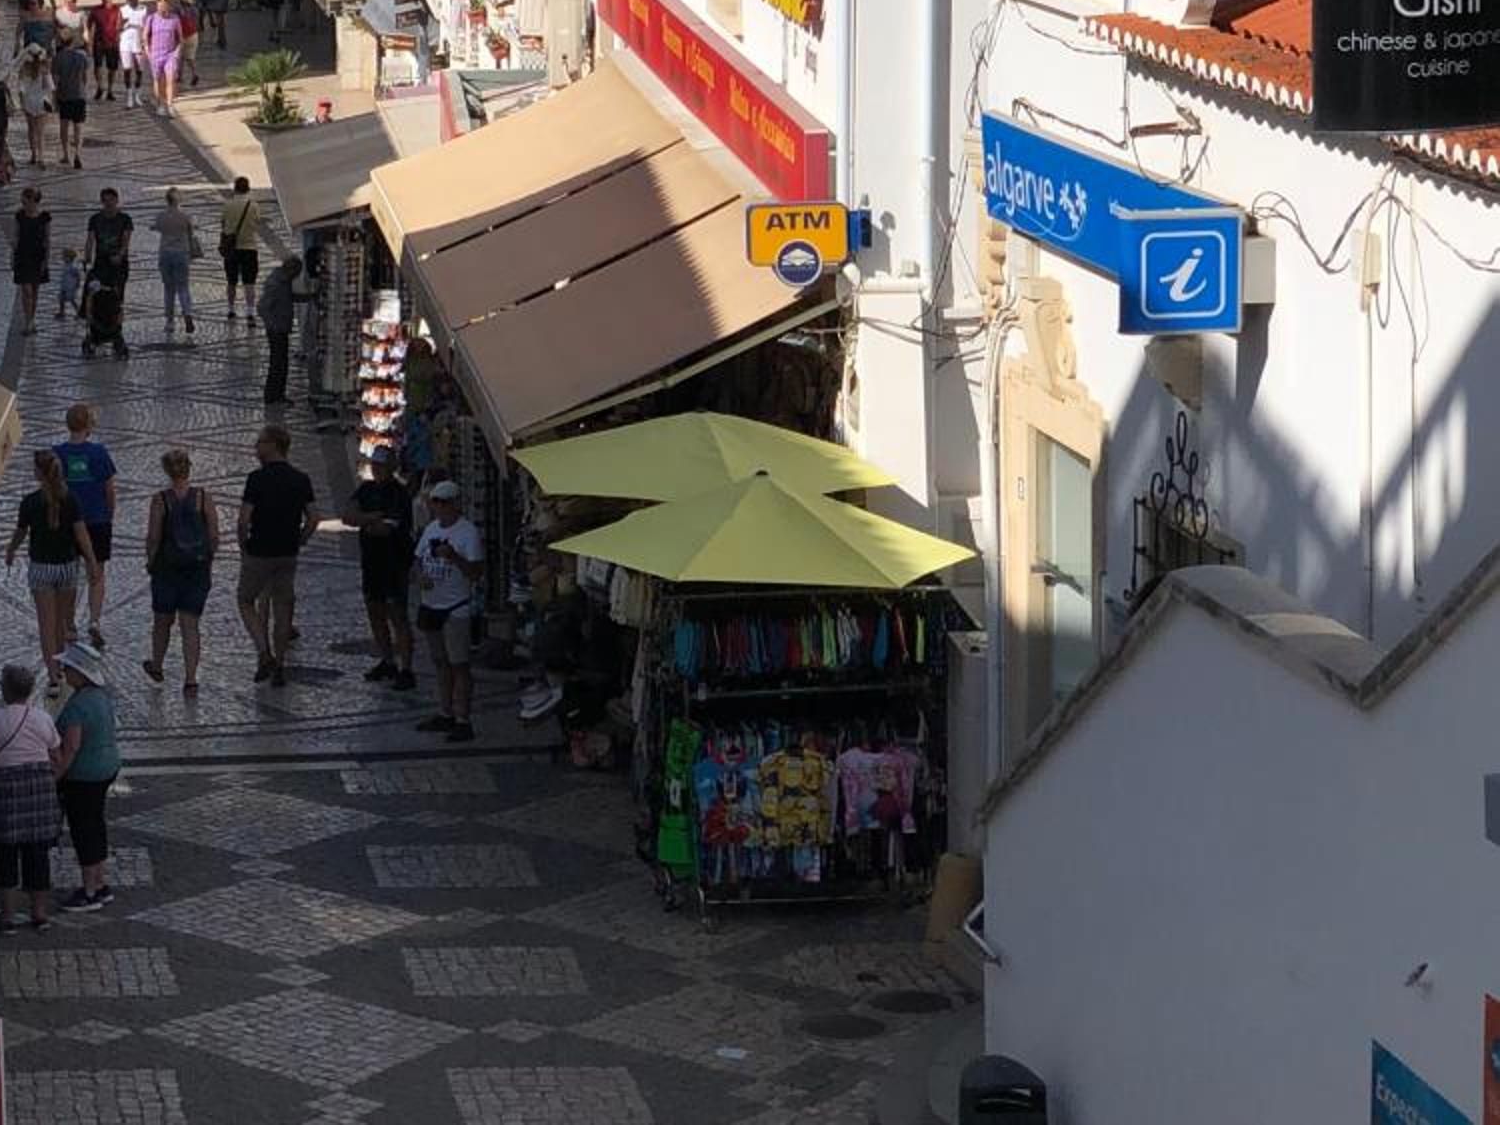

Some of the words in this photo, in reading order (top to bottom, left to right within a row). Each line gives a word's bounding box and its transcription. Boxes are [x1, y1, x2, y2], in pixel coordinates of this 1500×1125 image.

[1337, 29, 1418, 52] chinese
[1423, 31, 1438, 51] &
[1407, 58, 1471, 78] cuisine
[986, 140, 1056, 221] algarve
[766, 210, 832, 231] ATM
